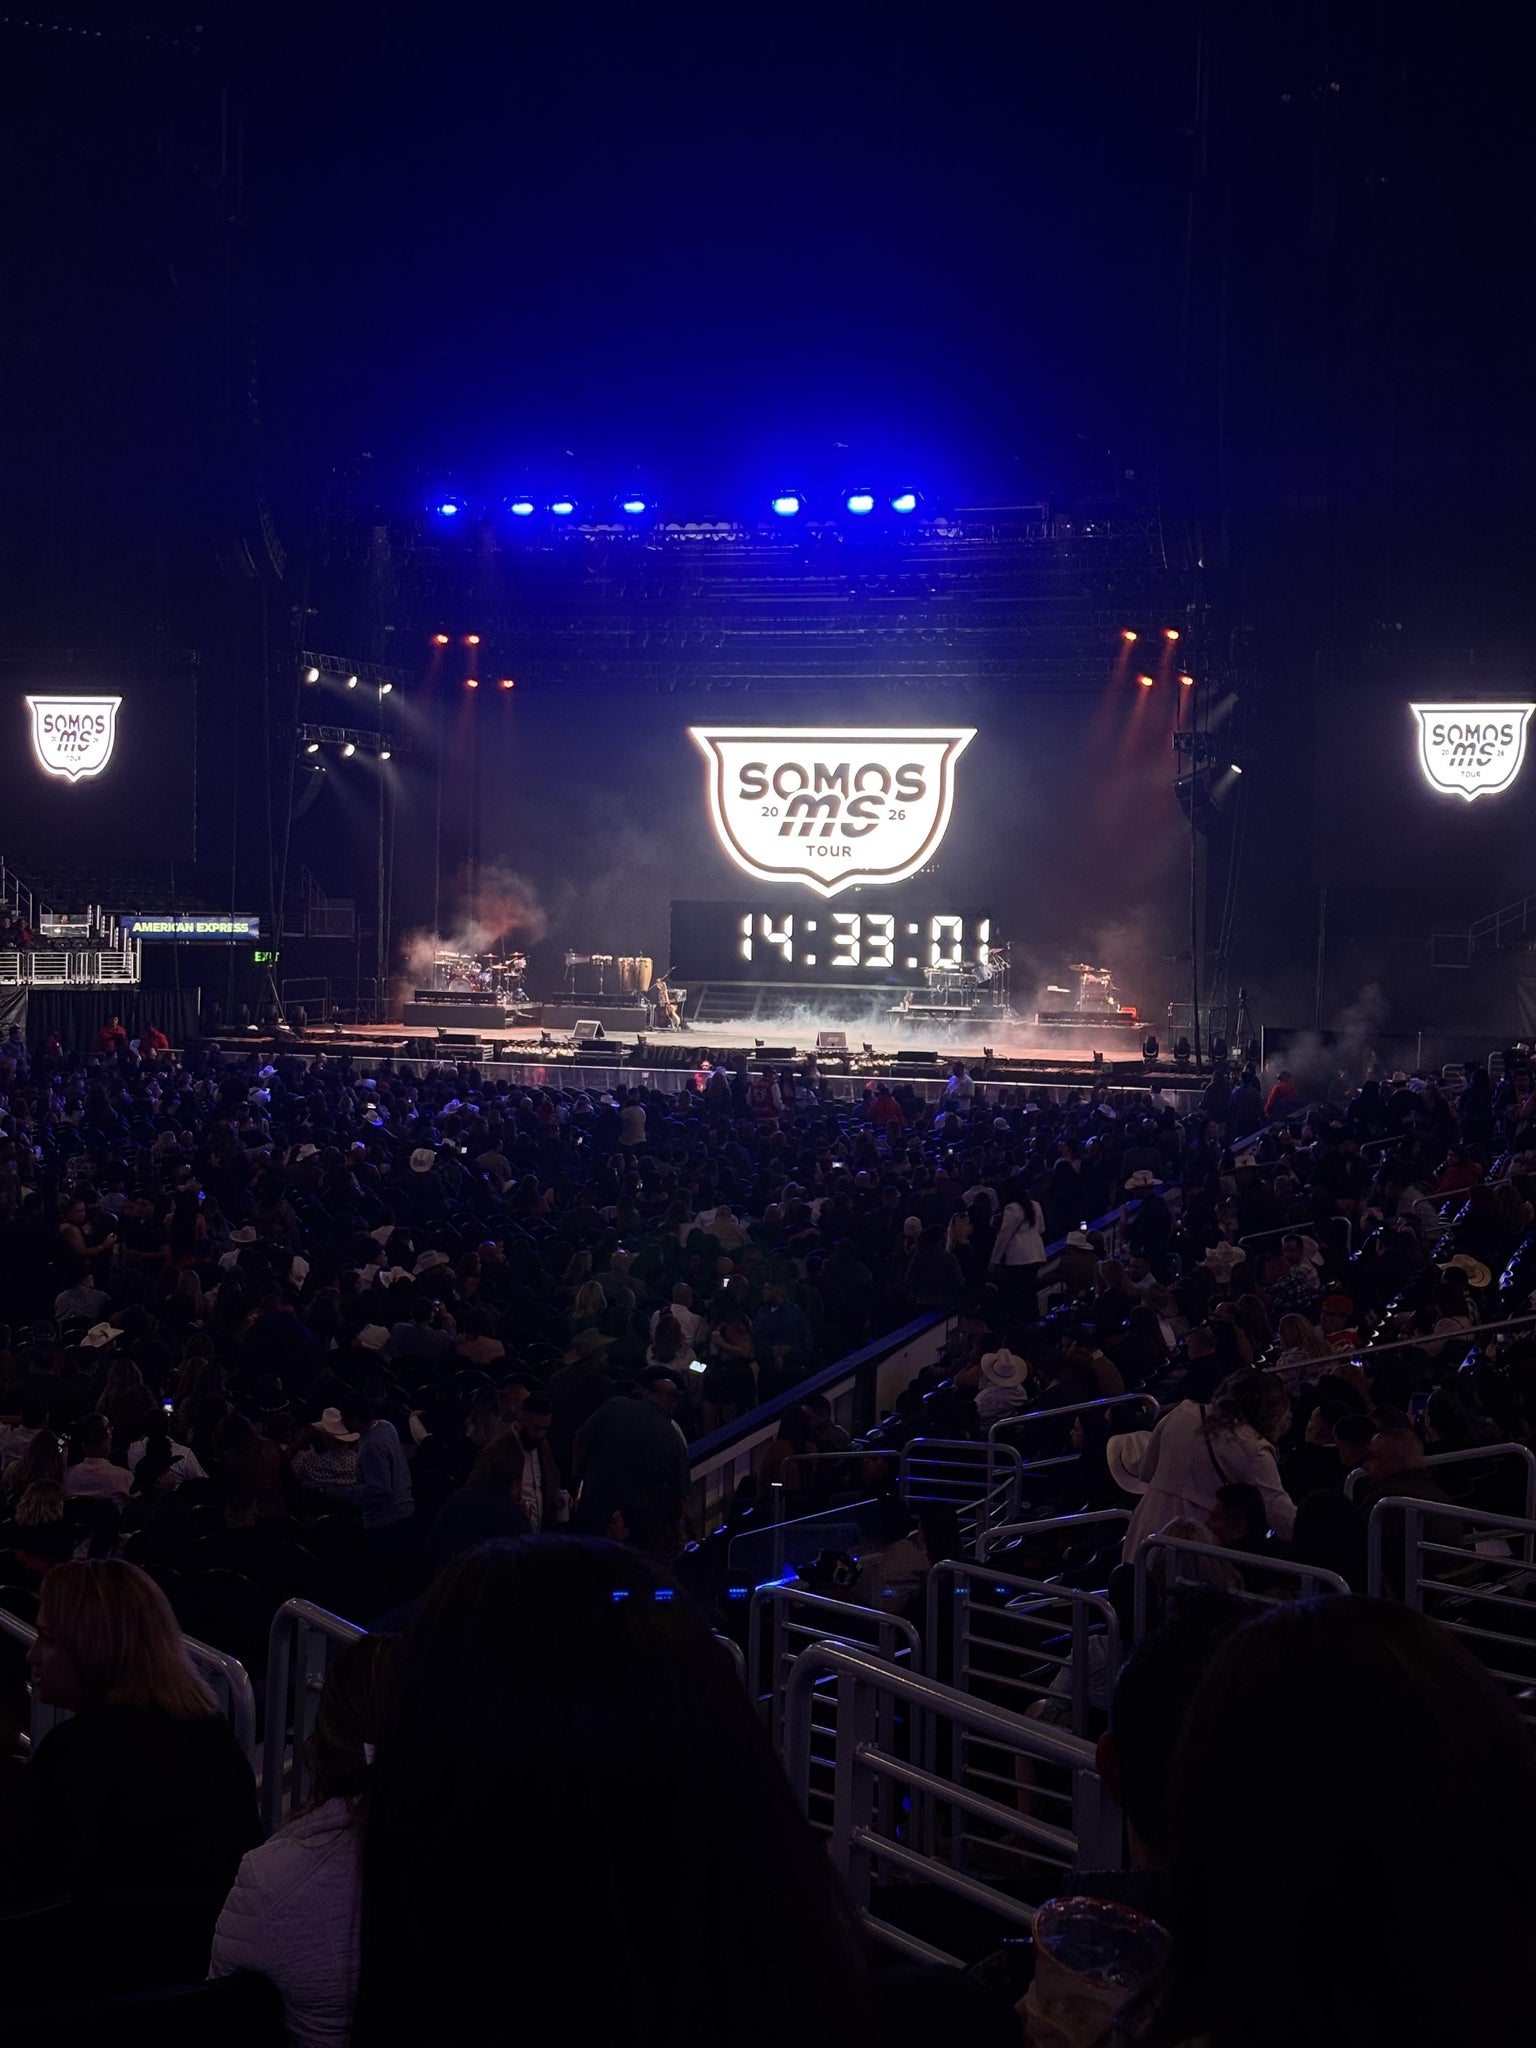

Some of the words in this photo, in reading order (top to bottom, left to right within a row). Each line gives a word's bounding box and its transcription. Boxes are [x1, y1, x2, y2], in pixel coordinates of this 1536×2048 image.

[43, 713, 105, 734] SOMOS
[1432, 724, 1514, 746] SOMOS
[739, 762, 926, 802] SOMOS
[761, 806, 779, 817] 20
[888, 809, 906, 821] 26
[806, 845, 852, 857] TOUR
[132, 922, 194, 932] AMERICAN
[196, 922, 249, 933] EXPRESS
[741, 913, 990, 968] 14:33:01
[254, 951, 280, 962] EXIT
